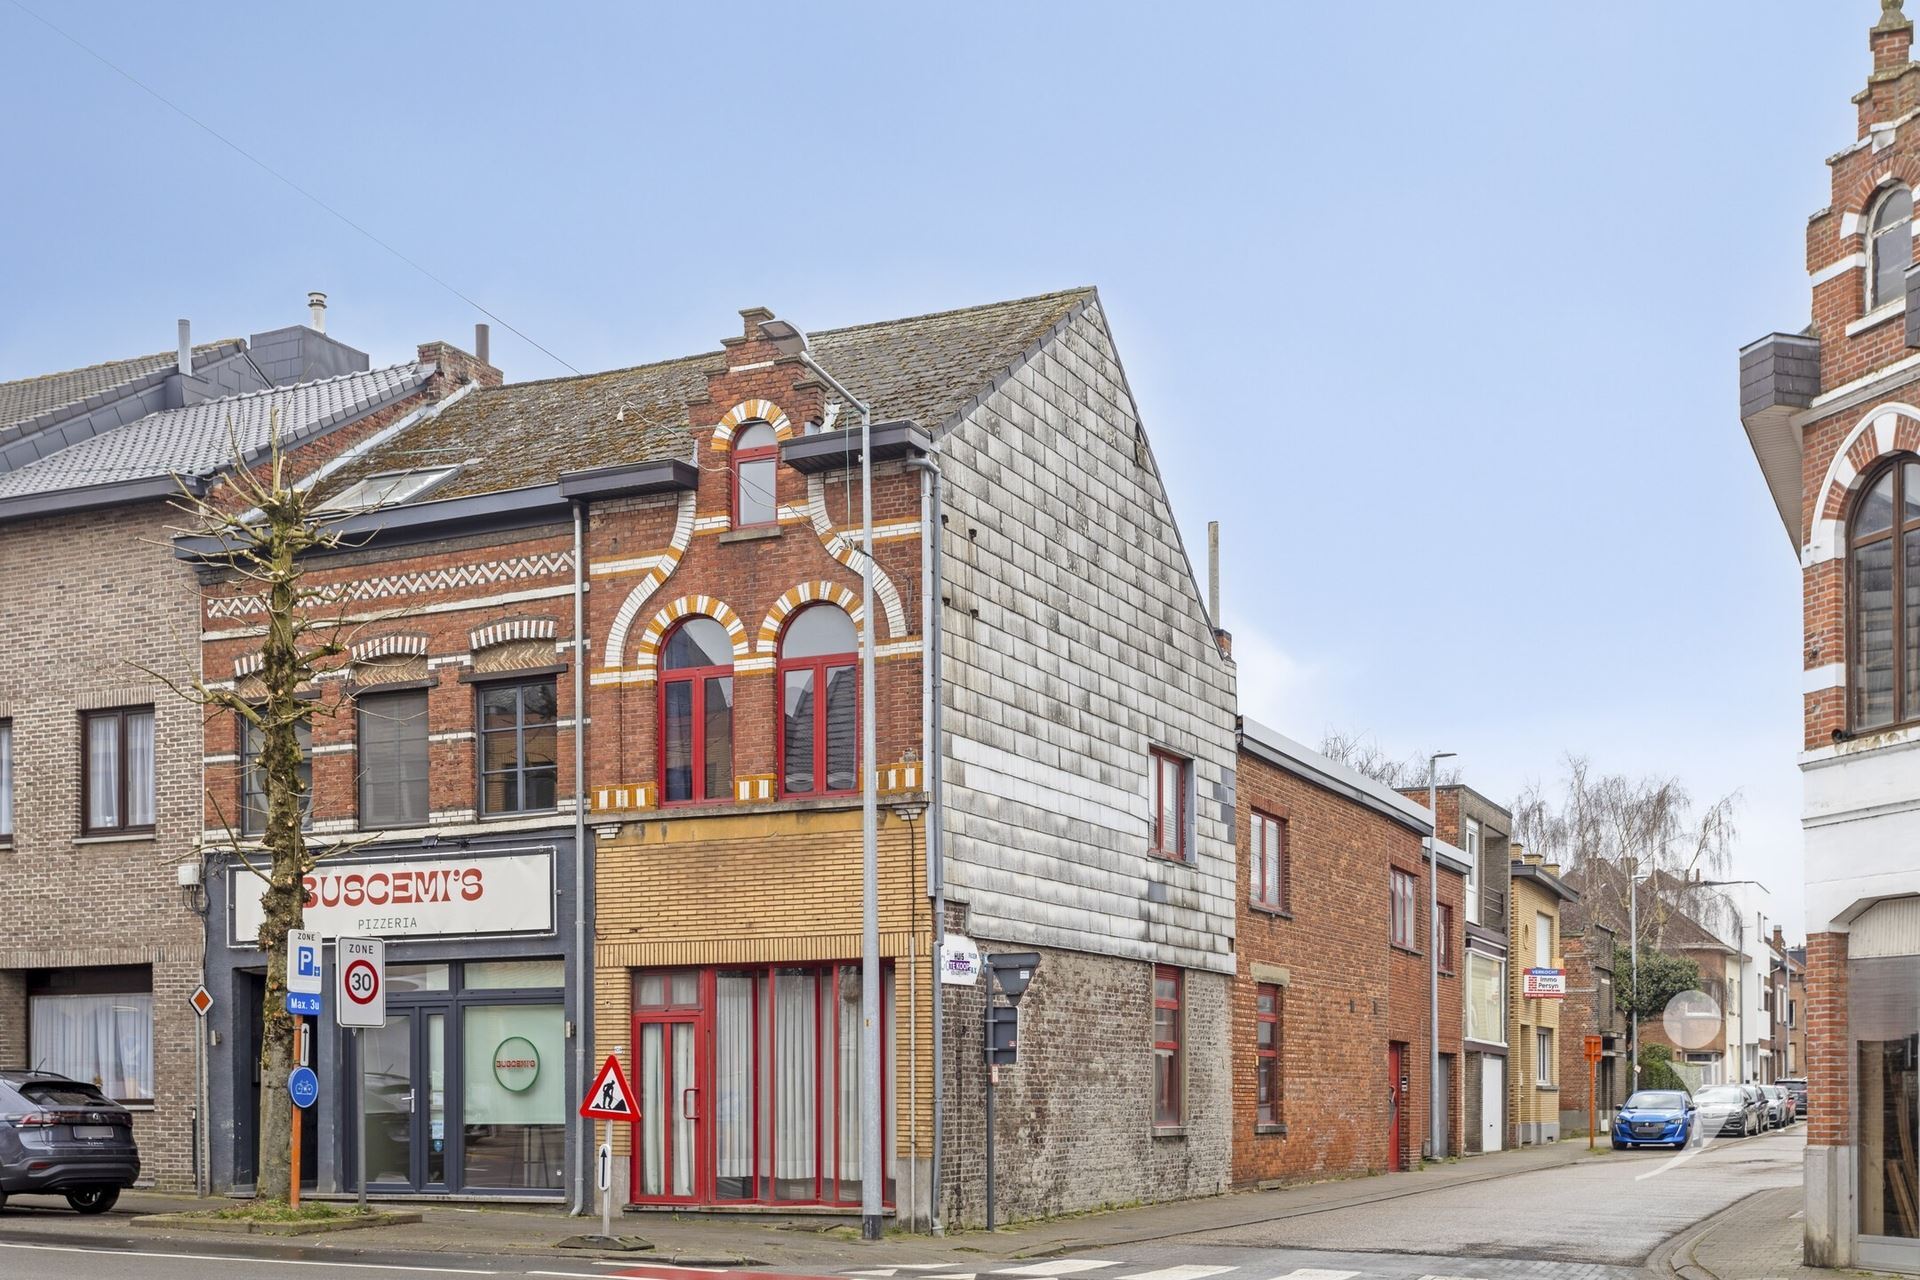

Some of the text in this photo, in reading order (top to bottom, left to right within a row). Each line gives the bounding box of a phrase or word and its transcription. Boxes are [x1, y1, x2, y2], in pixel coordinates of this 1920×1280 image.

[302, 868, 484, 909] BUSCEMI'S
[358, 917, 418, 930] PIZZERIA
[297, 932, 316, 942] ZONE
[349, 943, 375, 955] ZONE
[300, 950, 312, 971] P
[954, 952, 965, 960] HUIS
[351, 972, 372, 992] 30
[290, 998, 320, 1010] Max. 3u
